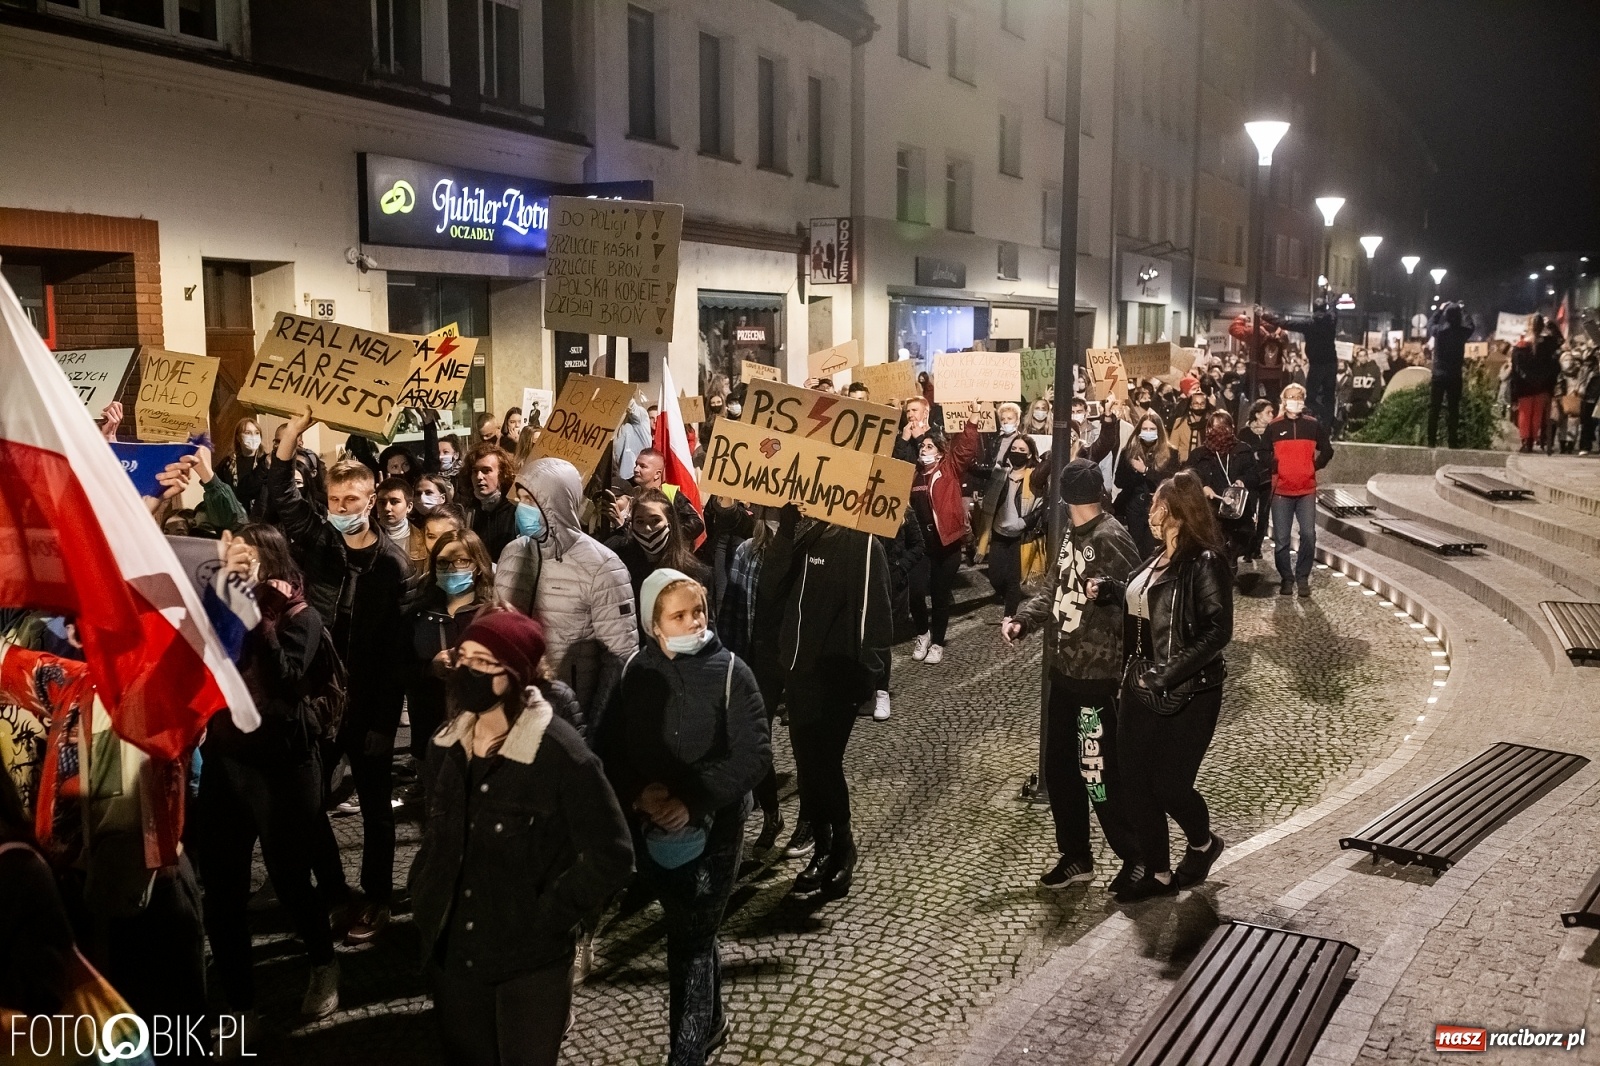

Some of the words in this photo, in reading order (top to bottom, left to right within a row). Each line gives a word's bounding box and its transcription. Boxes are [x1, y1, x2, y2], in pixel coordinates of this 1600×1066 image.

[432, 178, 502, 233] Jubiler
[558, 210, 585, 226] DO
[449, 225, 495, 241] OCZADŁY
[603, 242, 640, 258] KASKI
[607, 260, 643, 278] BROŃ
[556, 276, 608, 299] POLSKA
[317, 303, 334, 316] 36
[598, 302, 648, 325] BROŃ
[276, 316, 343, 350] REAL
[349, 333, 402, 366] MEN
[737, 330, 766, 341] PRZECENA
[54, 352, 88, 365] ARA
[287, 348, 358, 383] ARE
[938, 356, 955, 367] NO
[64, 371, 109, 382] SZYCH
[434, 358, 469, 383] NIE
[250, 362, 396, 418] FEMINISTS
[566, 379, 588, 405] To
[993, 380, 1016, 390] BABY
[141, 384, 198, 408] CIAŁO
[139, 408, 171, 420] moja
[946, 411, 969, 419] SMALL
[979, 411, 992, 419] ICK
[830, 408, 896, 454] OFF
